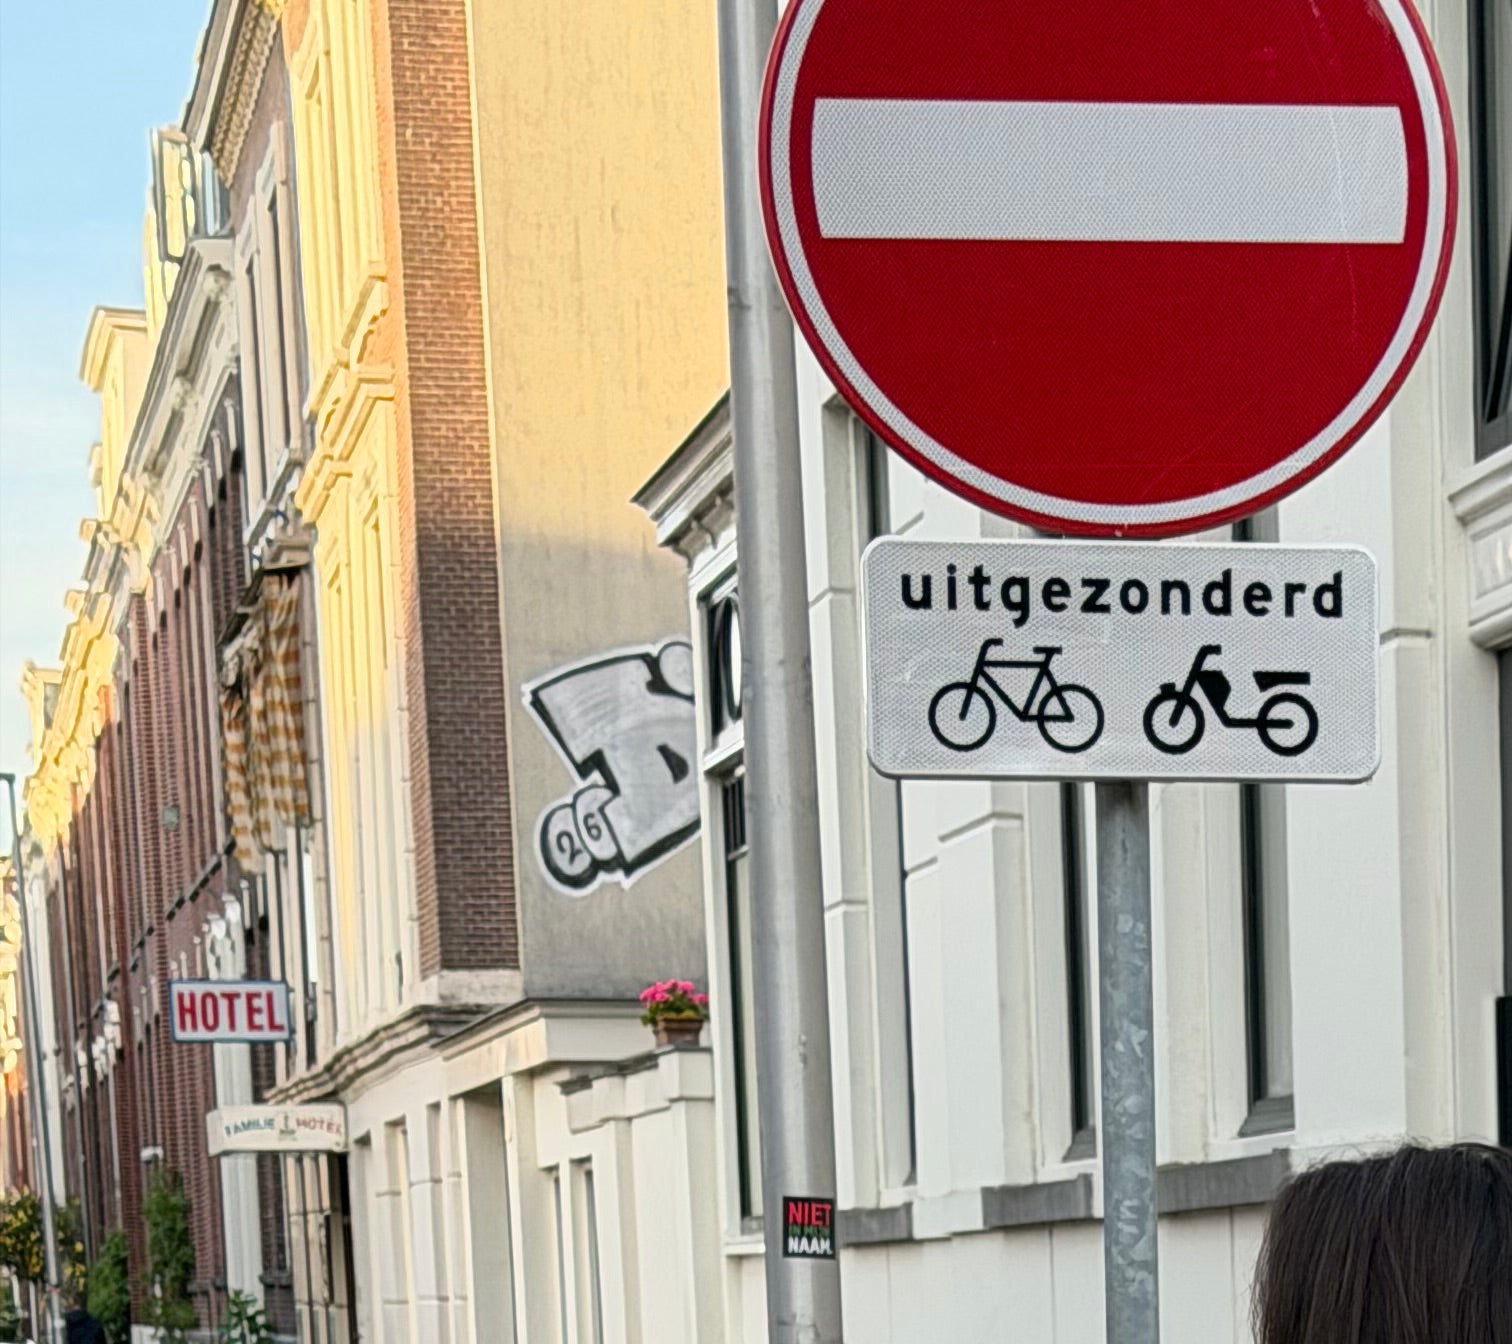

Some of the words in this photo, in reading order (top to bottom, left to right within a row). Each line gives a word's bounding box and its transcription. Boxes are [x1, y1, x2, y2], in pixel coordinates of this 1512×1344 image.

[900, 563, 1344, 628] uitgezonderd
[176, 990, 285, 1033] HOTEL
[224, 1117, 275, 1137] FAMILIE
[295, 1117, 342, 1137] HOTEL
[788, 1202, 832, 1227] NIET
